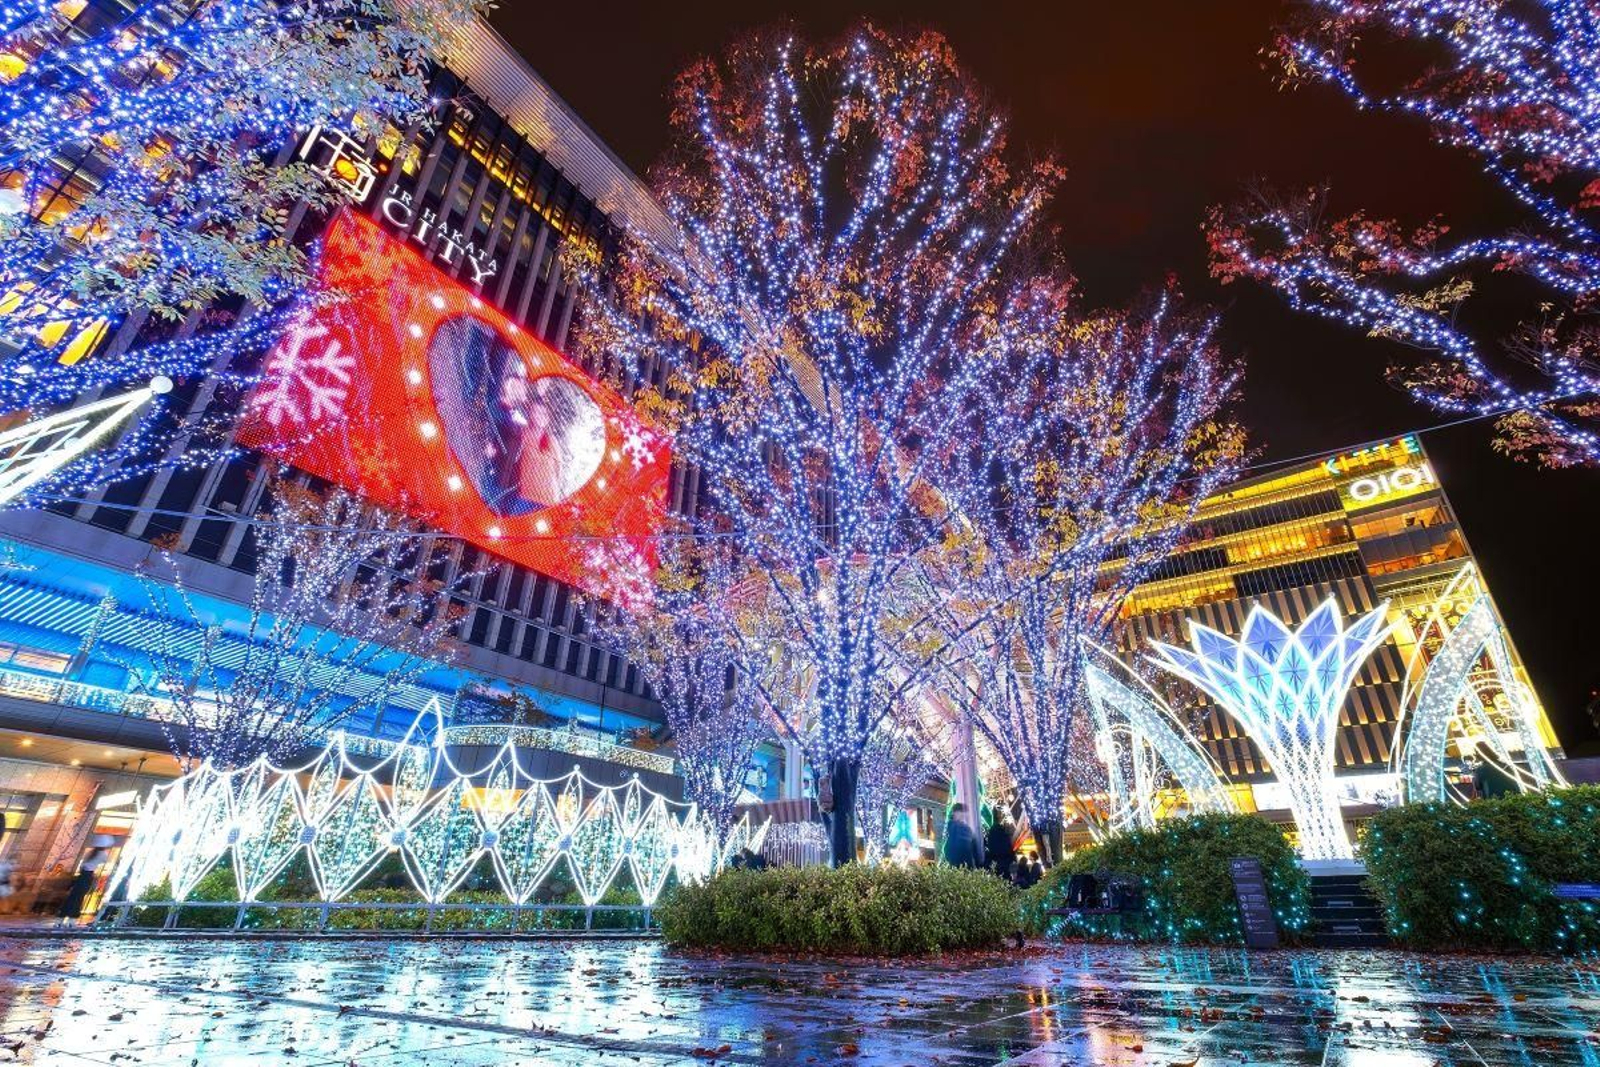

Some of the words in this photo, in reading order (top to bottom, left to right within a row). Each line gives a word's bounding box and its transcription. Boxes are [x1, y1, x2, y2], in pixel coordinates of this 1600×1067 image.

[382, 197, 496, 286] CITY
[388, 183, 413, 206] JR
[424, 207, 497, 271] HAKATA
[1320, 436, 1419, 475] KITTE
